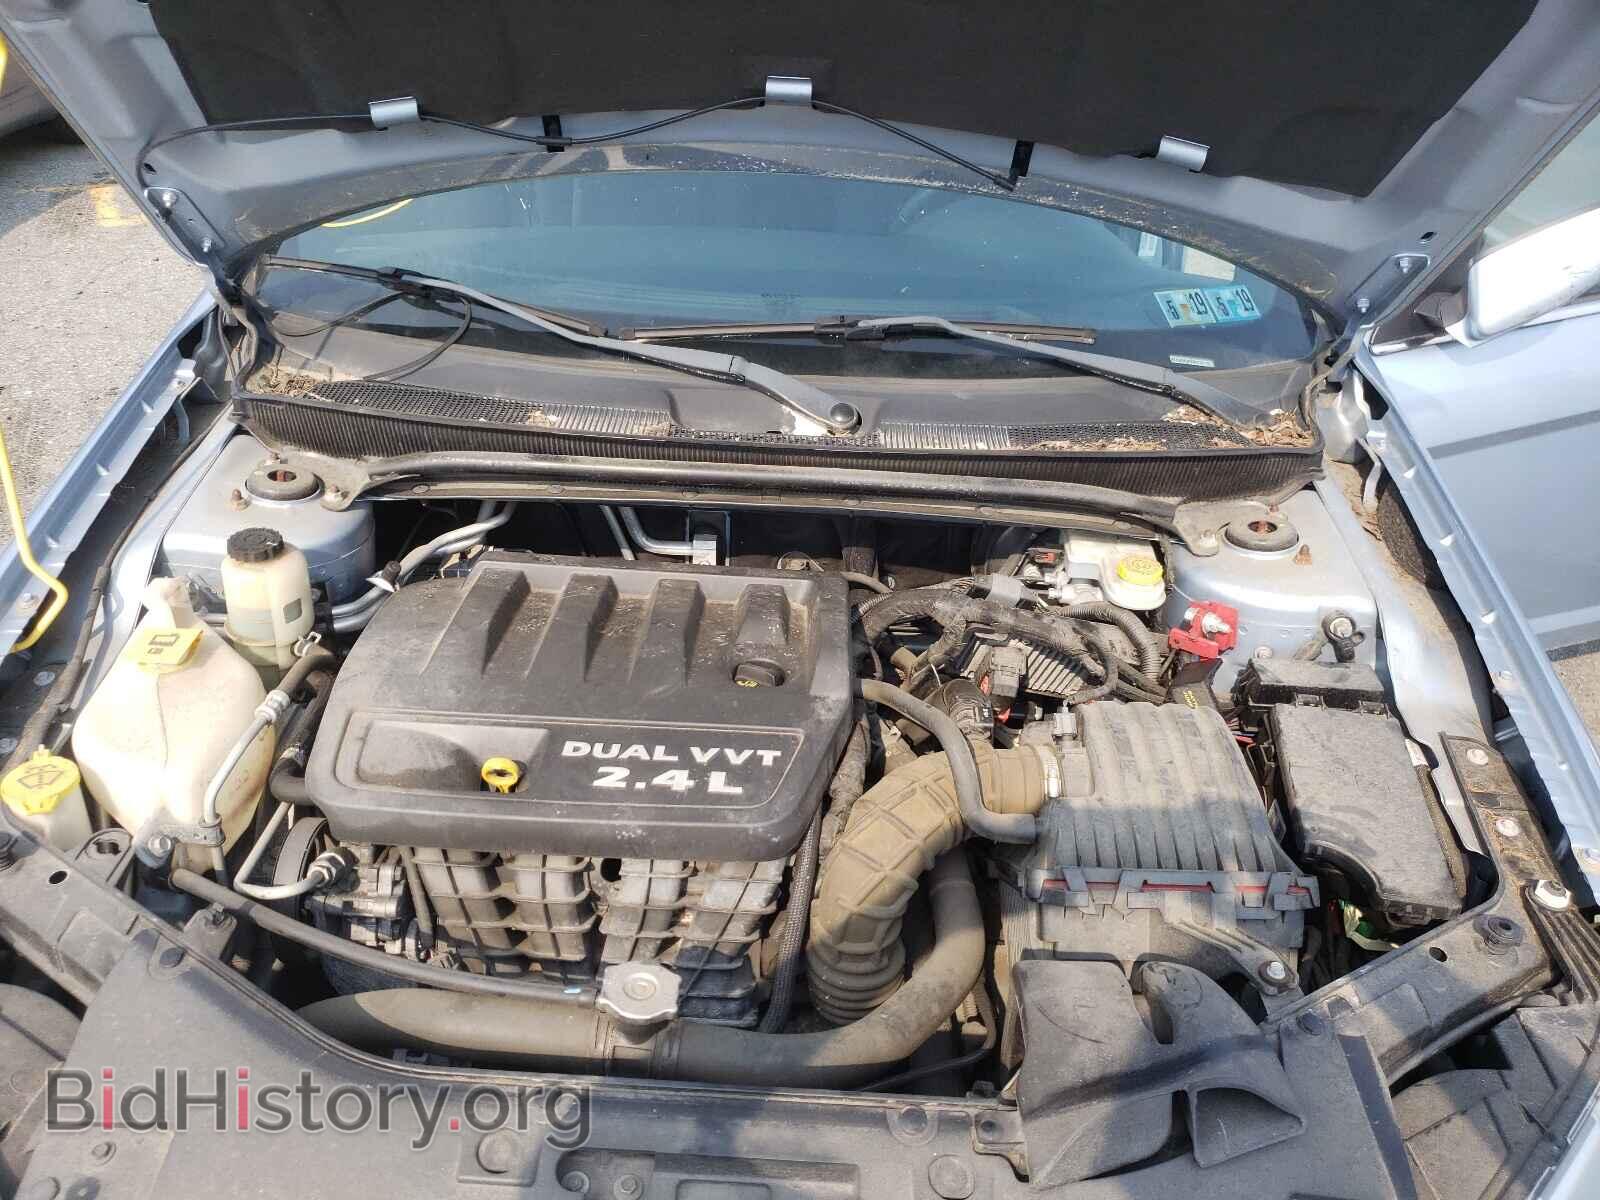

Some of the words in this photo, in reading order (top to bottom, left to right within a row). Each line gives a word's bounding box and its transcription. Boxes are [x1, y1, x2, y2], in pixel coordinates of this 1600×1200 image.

[1165, 300, 1180, 320] 5
[1188, 292, 1209, 315] 19
[1216, 296, 1231, 317] 5
[1235, 288, 1255, 312] 19
[561, 740, 680, 762] DUAL
[689, 746, 782, 767] VVT
